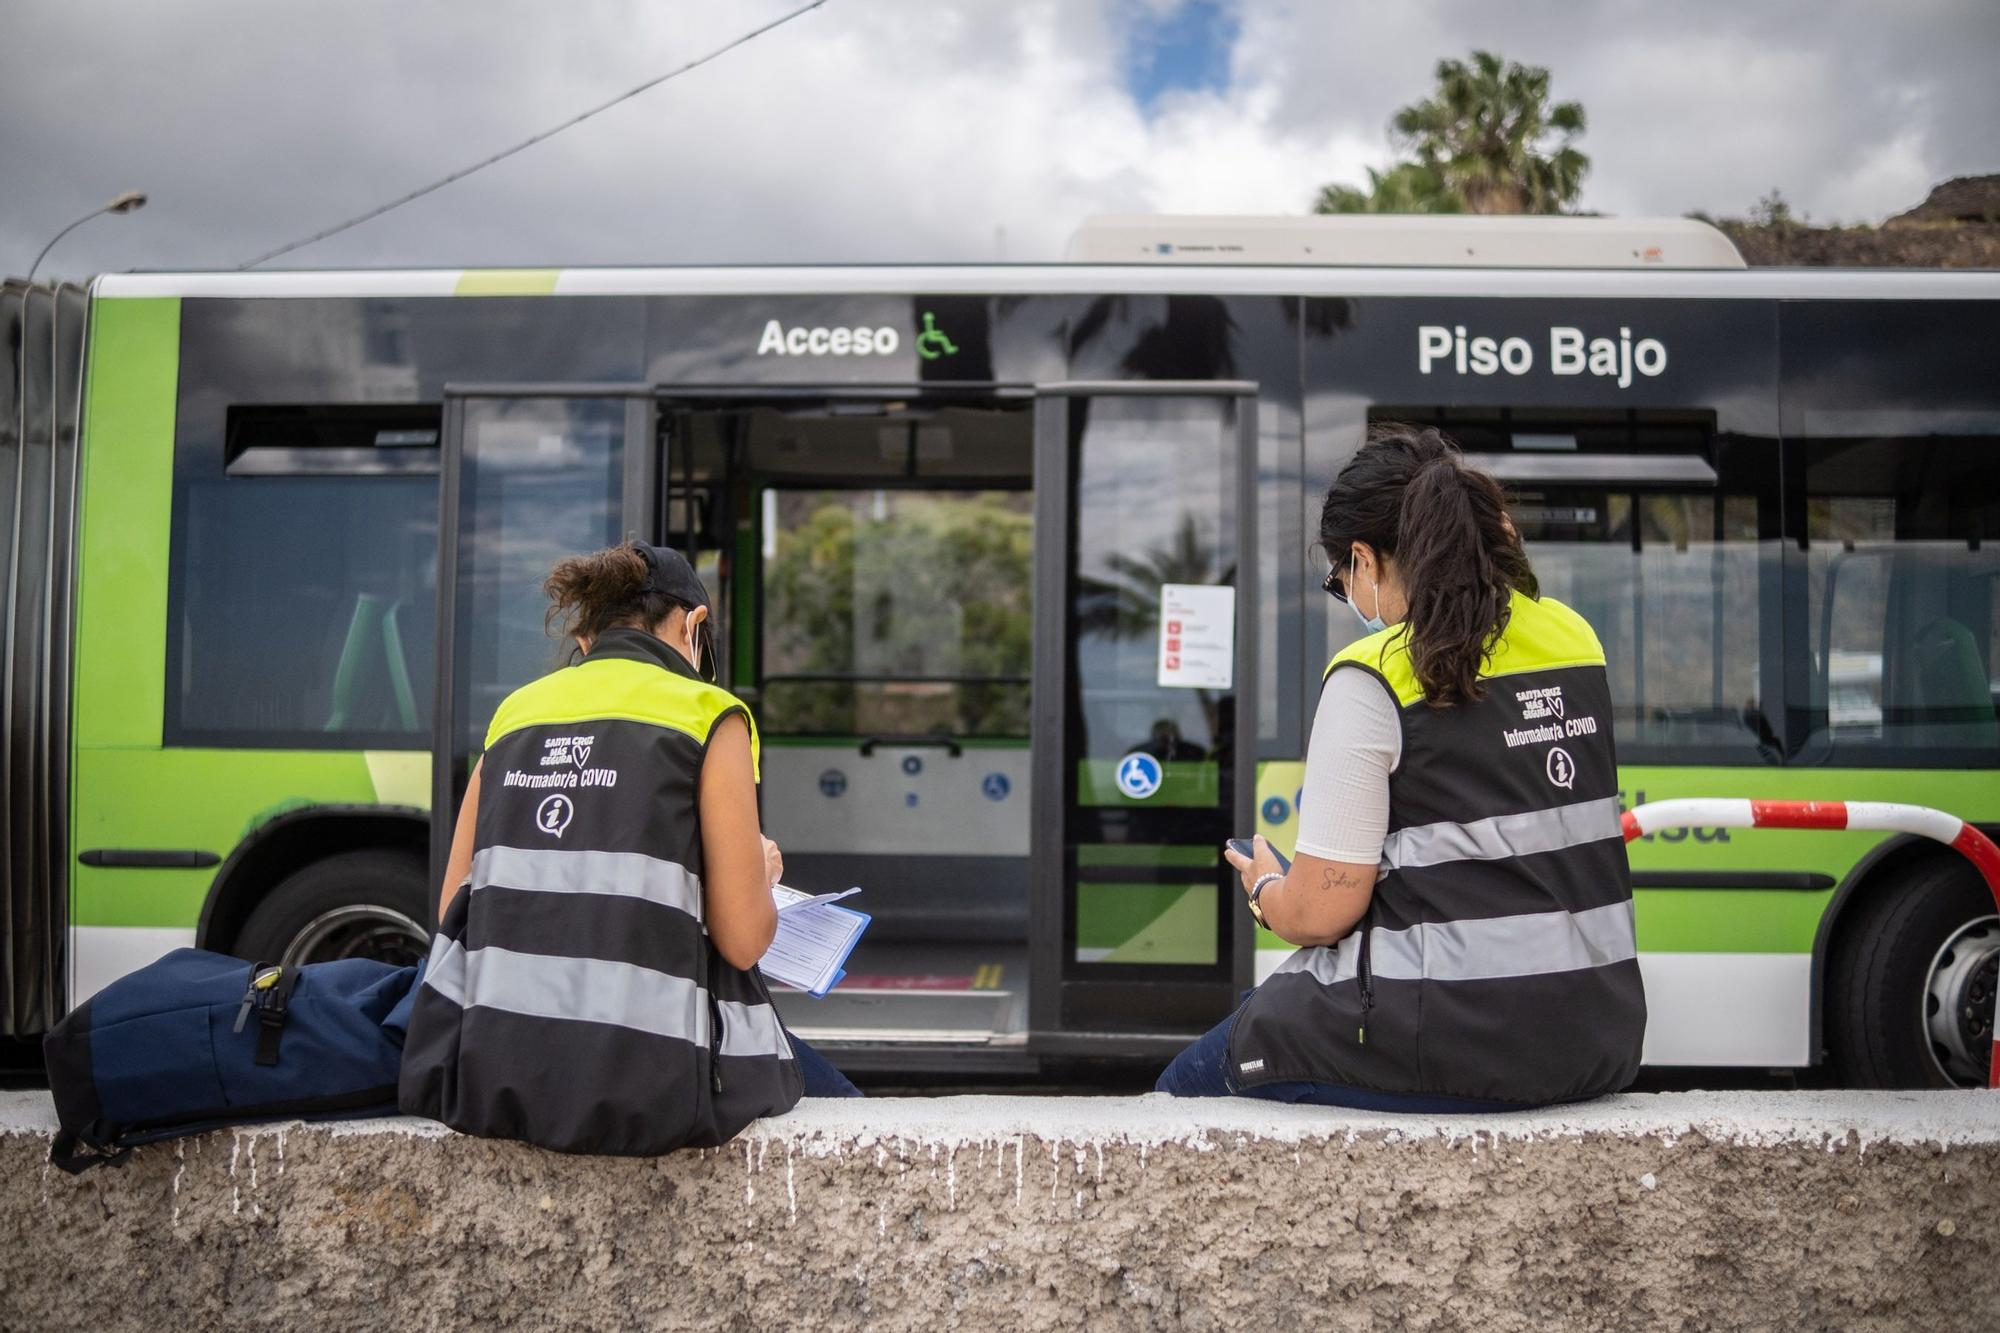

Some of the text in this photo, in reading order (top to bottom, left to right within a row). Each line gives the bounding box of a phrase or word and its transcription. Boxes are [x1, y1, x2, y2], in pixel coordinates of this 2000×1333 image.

[757, 319, 900, 355] Acceso
[1418, 325, 1668, 389] Piso Bajo
[1515, 686, 1562, 701] SANTA CRUZ
[1522, 707, 1552, 720] SEGURA
[1503, 716, 1598, 748] Informador/a COVID
[544, 735, 595, 748] SANTA CRUZ
[540, 754, 573, 766] SEGURA
[503, 768, 618, 789] Informador/a COVID
